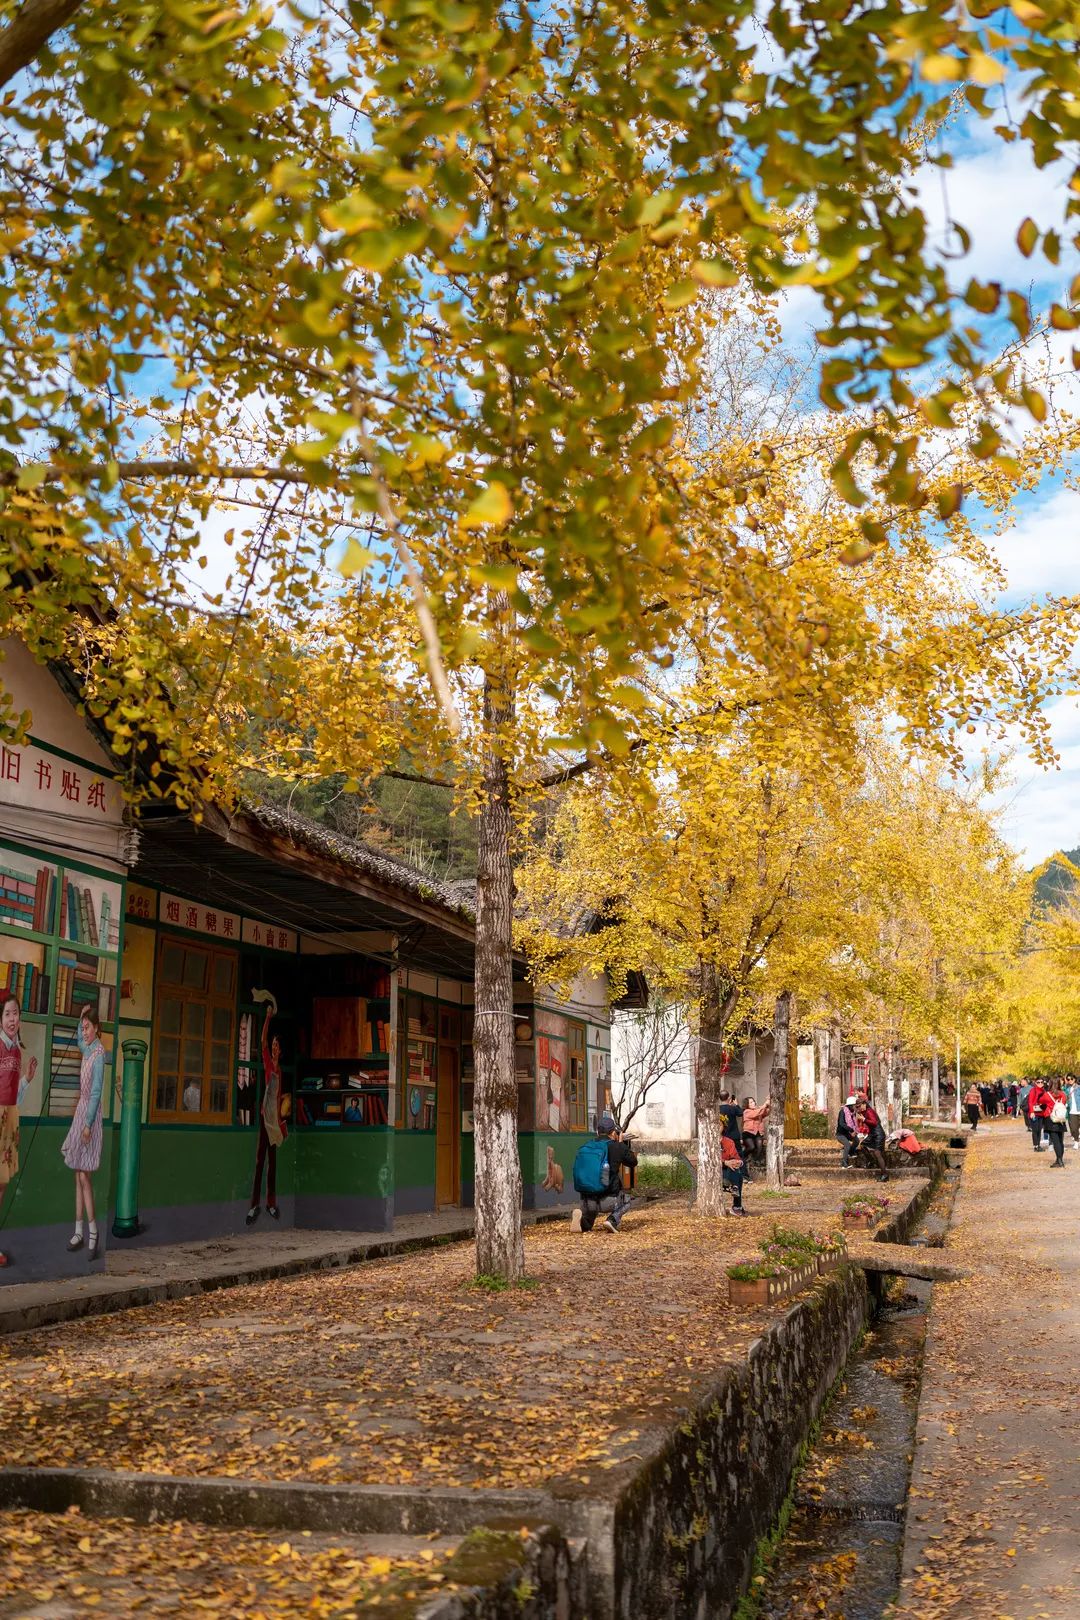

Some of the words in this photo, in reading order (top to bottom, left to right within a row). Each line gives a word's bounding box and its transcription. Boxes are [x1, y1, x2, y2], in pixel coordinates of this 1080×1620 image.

[1, 746, 106, 812] 旧书贴纸
[167, 899, 233, 937] 烟酒糖果
